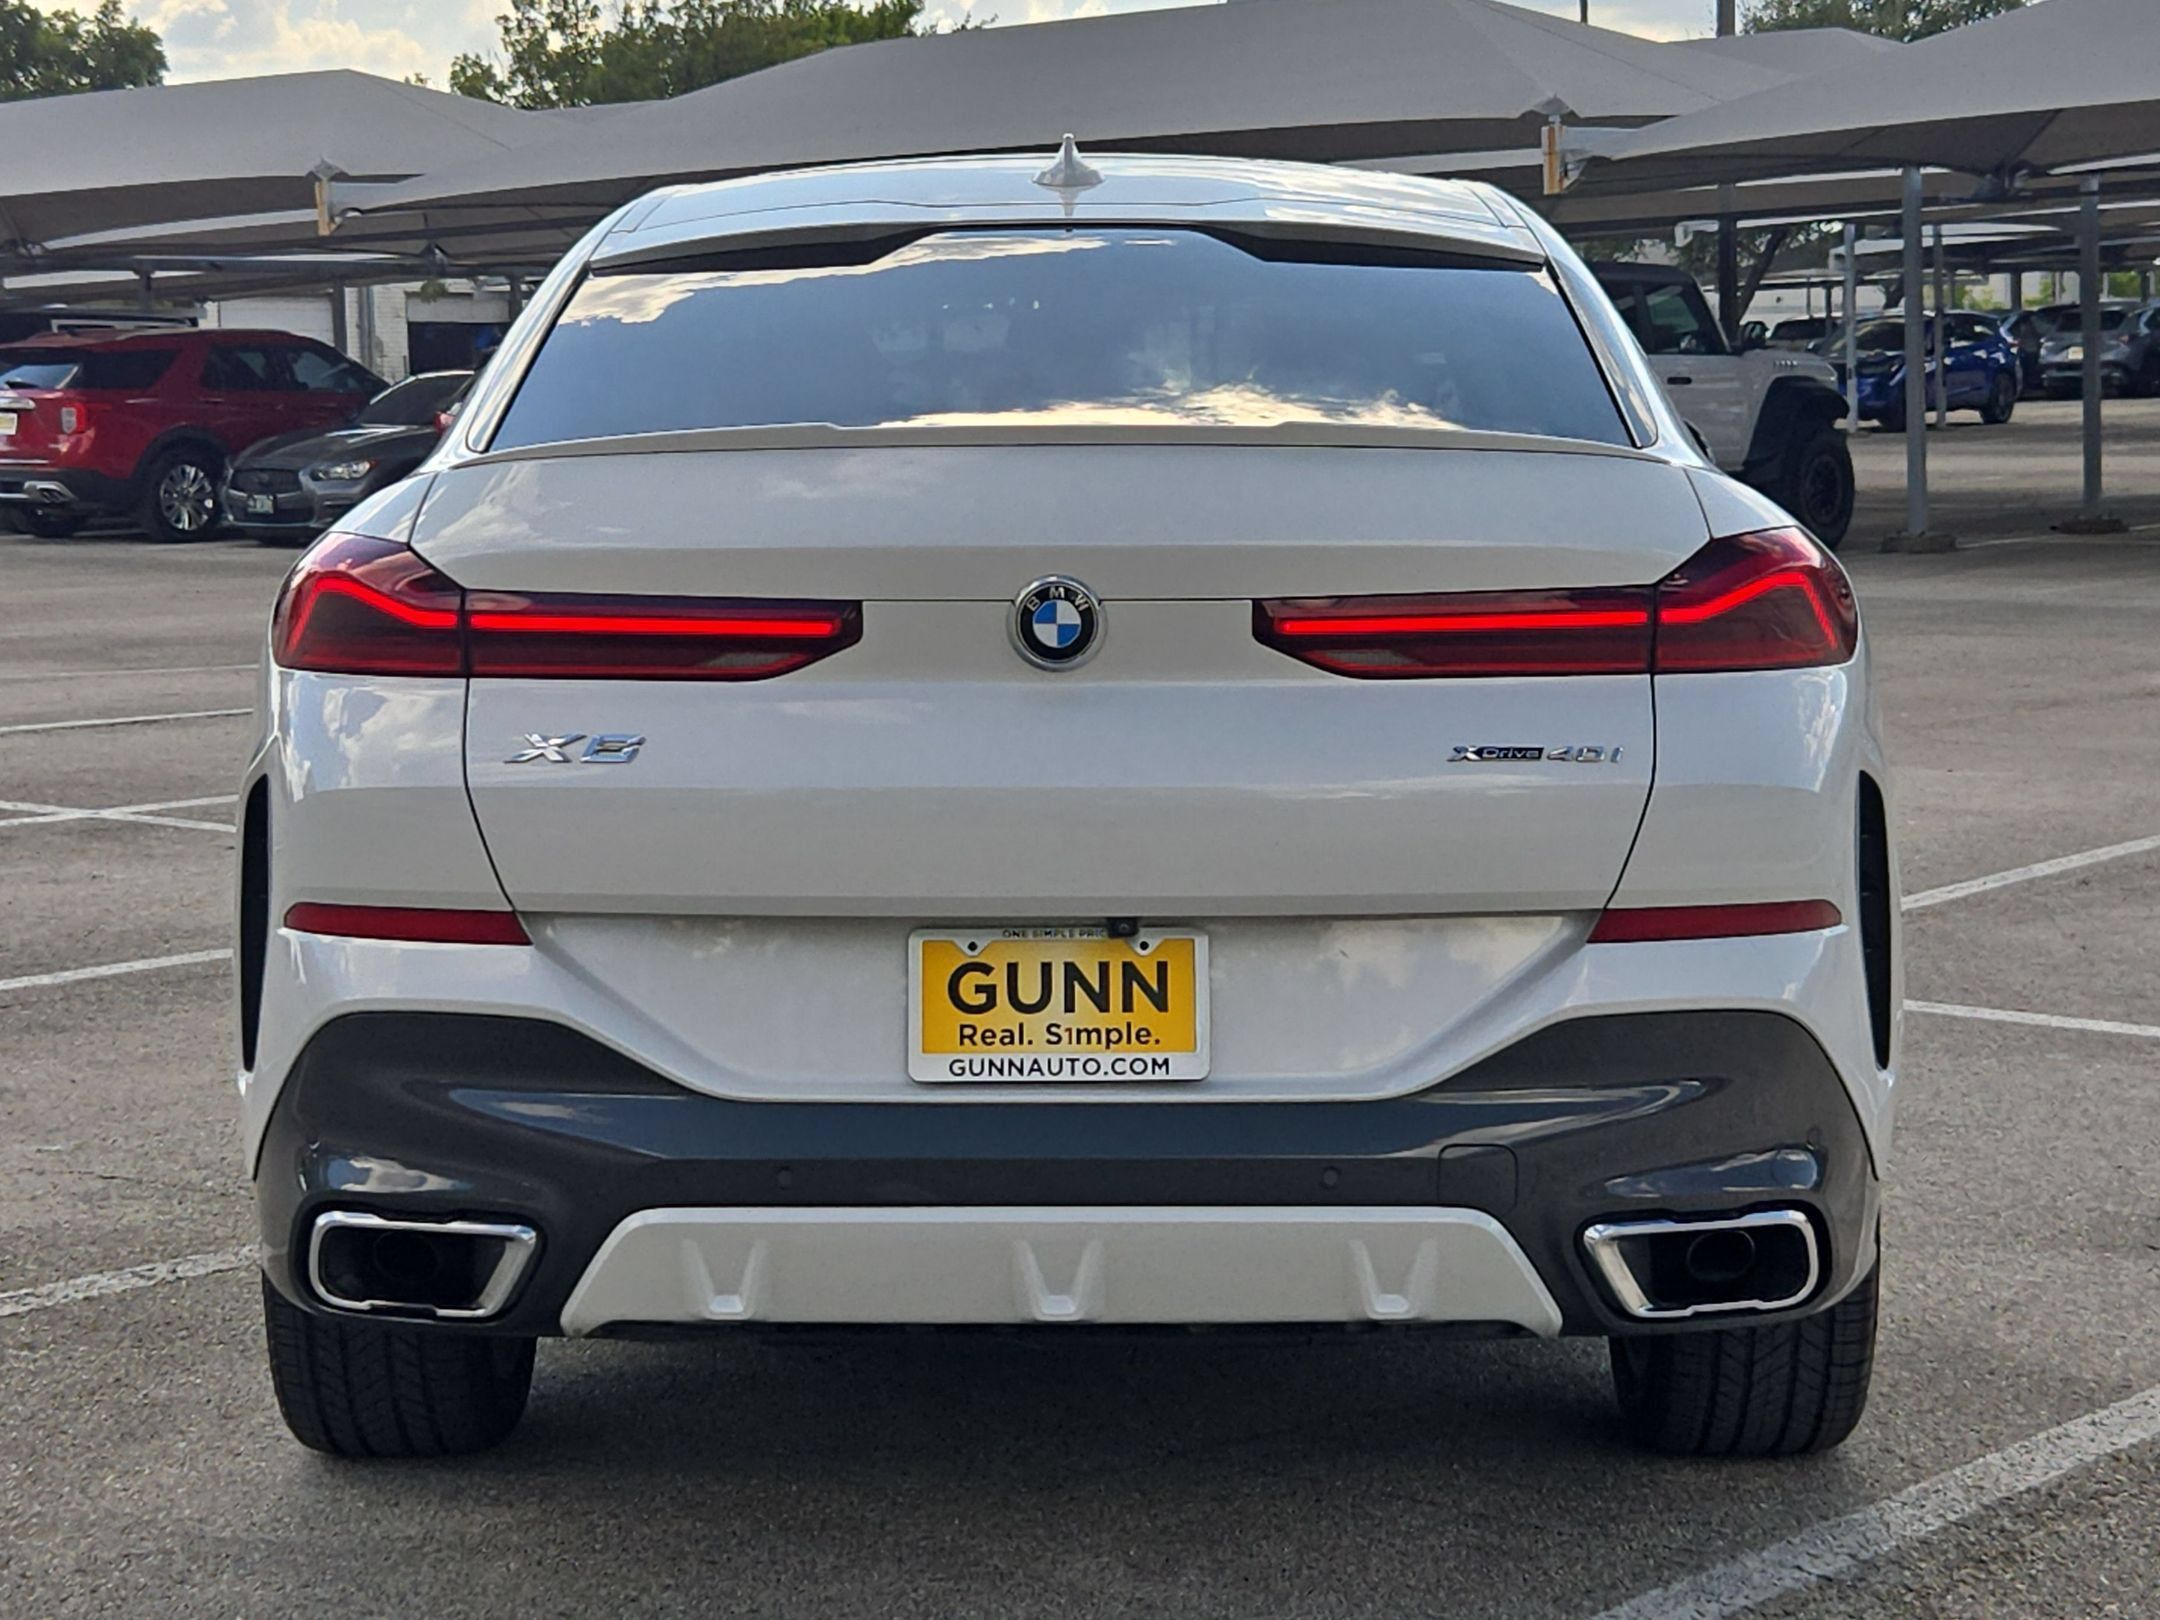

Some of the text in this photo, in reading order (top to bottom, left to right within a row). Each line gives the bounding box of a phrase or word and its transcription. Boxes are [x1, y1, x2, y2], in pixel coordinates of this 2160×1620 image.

[1026, 586, 1089, 611] BMW
[503, 732, 647, 763] X6
[1002, 927, 1025, 938] ONE
[948, 961, 1168, 1014] GUNN
[959, 1022, 1033, 1046] Real.
[948, 1057, 1170, 1076] GUNNAUTO.COM
